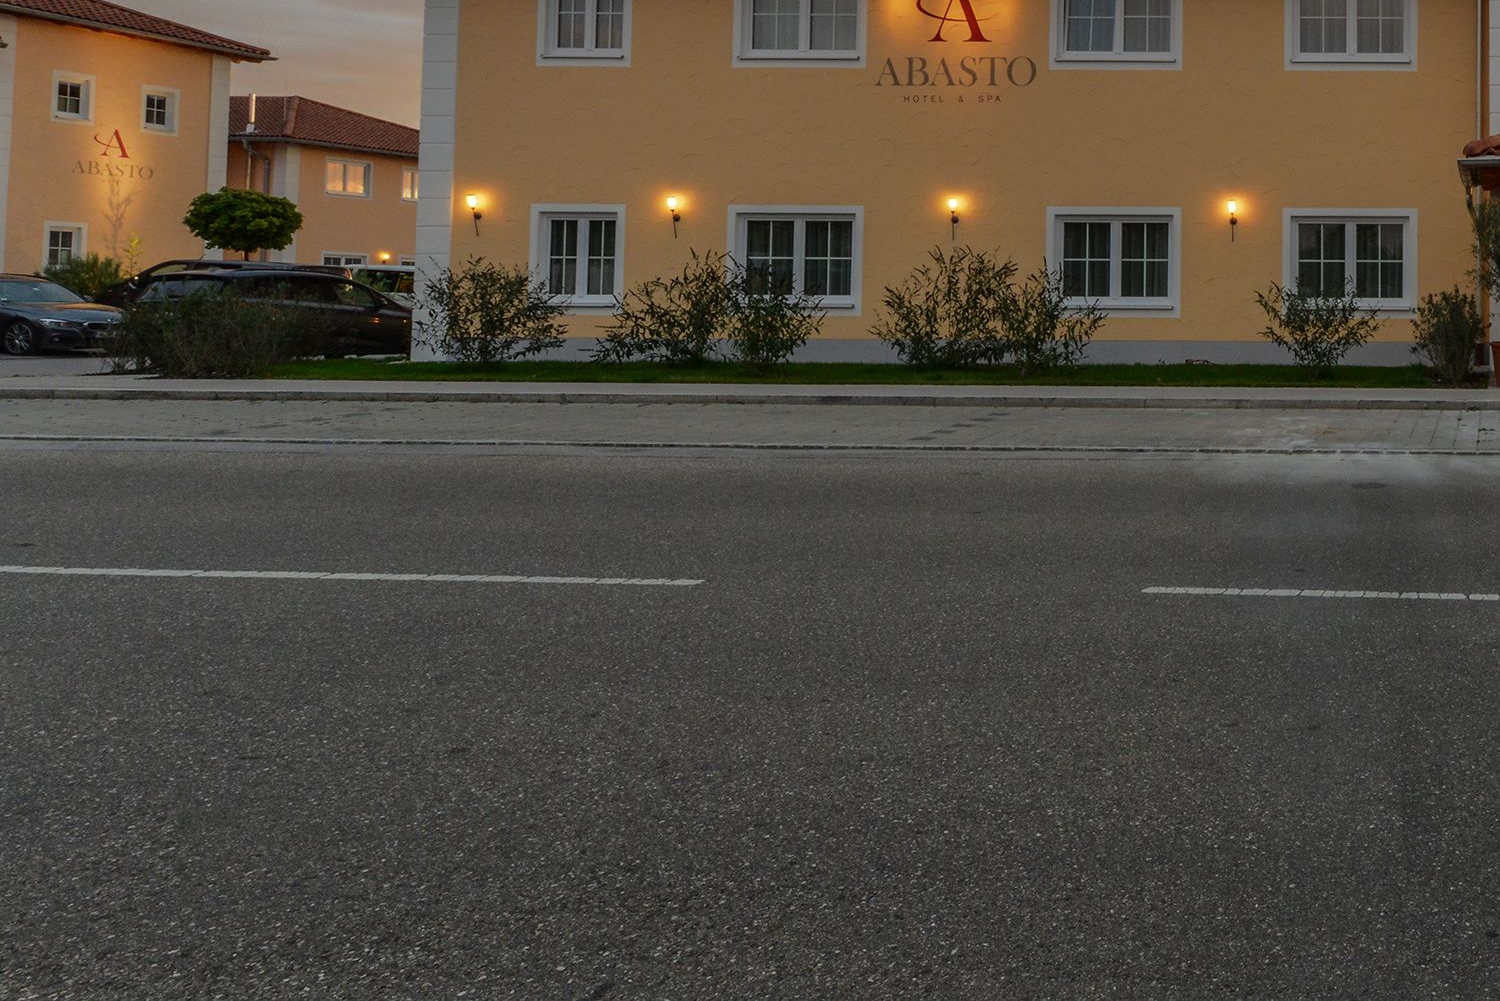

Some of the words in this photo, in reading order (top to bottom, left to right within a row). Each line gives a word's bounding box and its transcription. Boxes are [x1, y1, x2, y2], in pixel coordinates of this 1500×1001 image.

[875, 55, 1037, 87] ABASTO
[903, 95, 944, 103] HOTEL
[958, 95, 964, 103] &
[978, 95, 1002, 103] SPA
[94, 129, 131, 159] A
[72, 160, 154, 179] ABASTO
